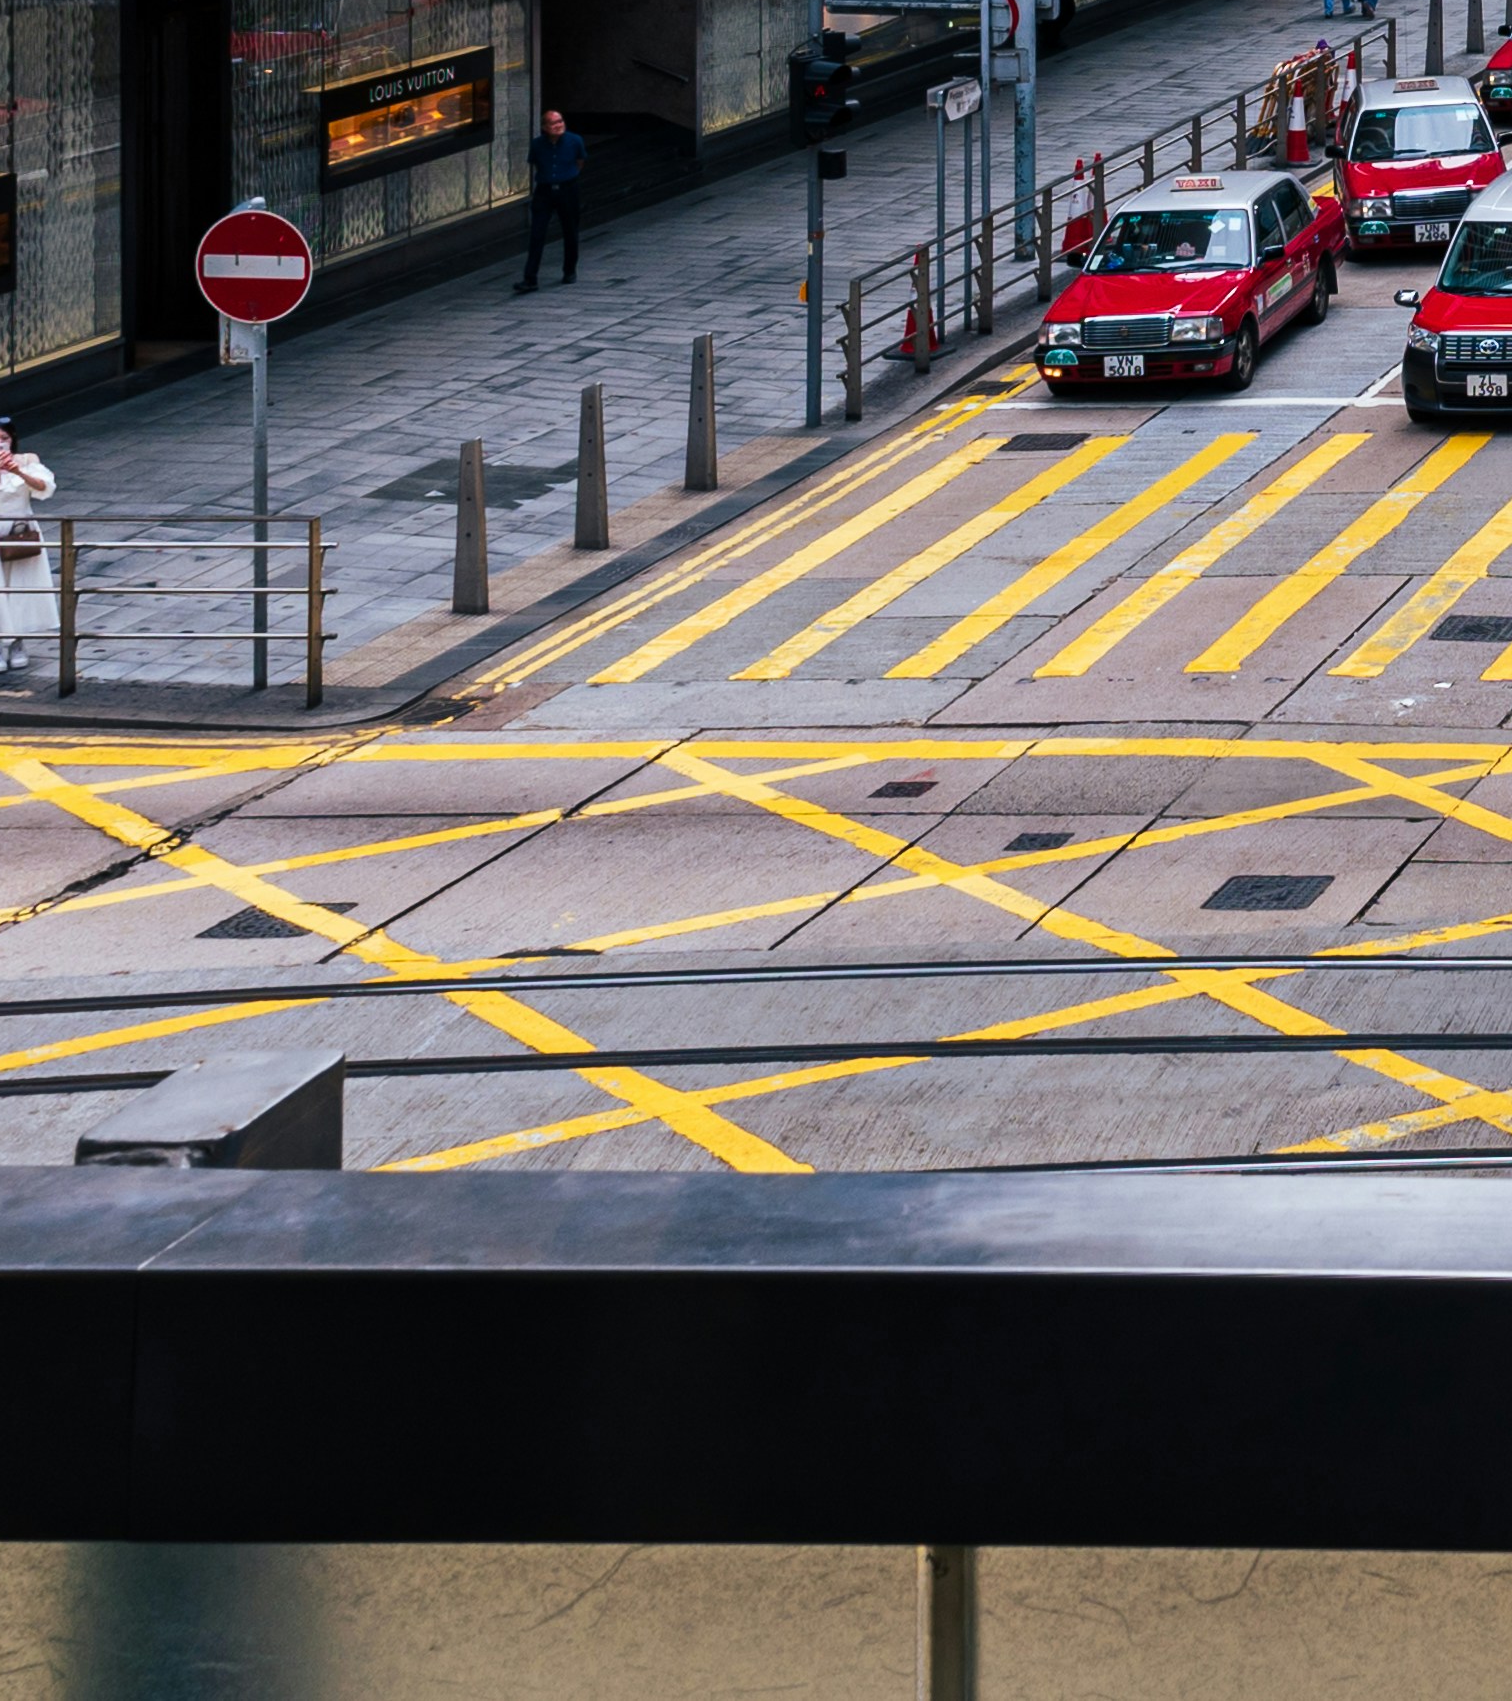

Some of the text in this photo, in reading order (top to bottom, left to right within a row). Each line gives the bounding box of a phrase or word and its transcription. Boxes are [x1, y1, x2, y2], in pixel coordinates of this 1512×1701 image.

[369, 65, 455, 103] LOUIS VUITTON
[1175, 178, 1218, 188] TAXI
[1424, 223, 1441, 234] UN
[1418, 232, 1447, 242] 7496
[1117, 355, 1135, 365] VN
[1109, 365, 1143, 377] 5018
[1472, 385, 1503, 396] 1398
